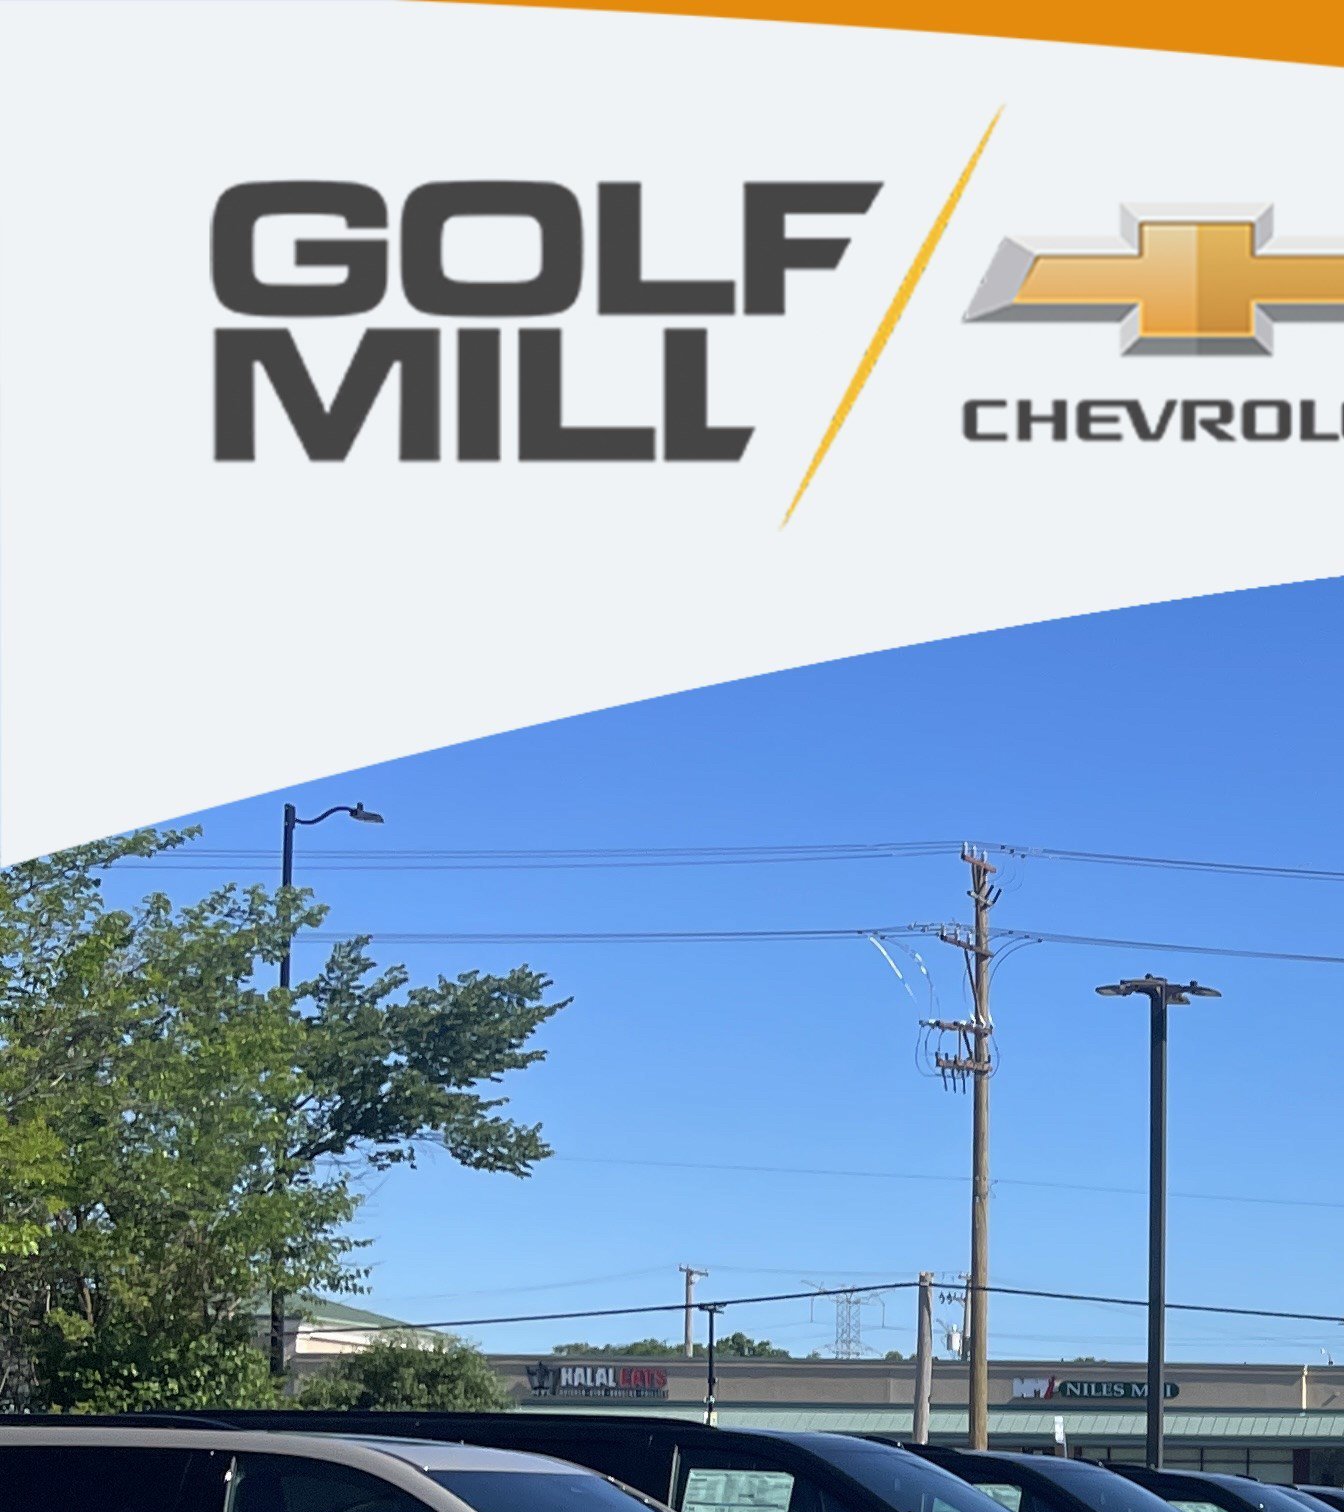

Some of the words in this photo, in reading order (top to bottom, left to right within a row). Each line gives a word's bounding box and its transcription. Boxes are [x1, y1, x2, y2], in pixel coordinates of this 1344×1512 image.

[560, 1366, 617, 1388] HALAL
[619, 1367, 668, 1389] EATS
[1066, 1381, 1125, 1398] NILES
[1131, 1382, 1172, 1398] MI
